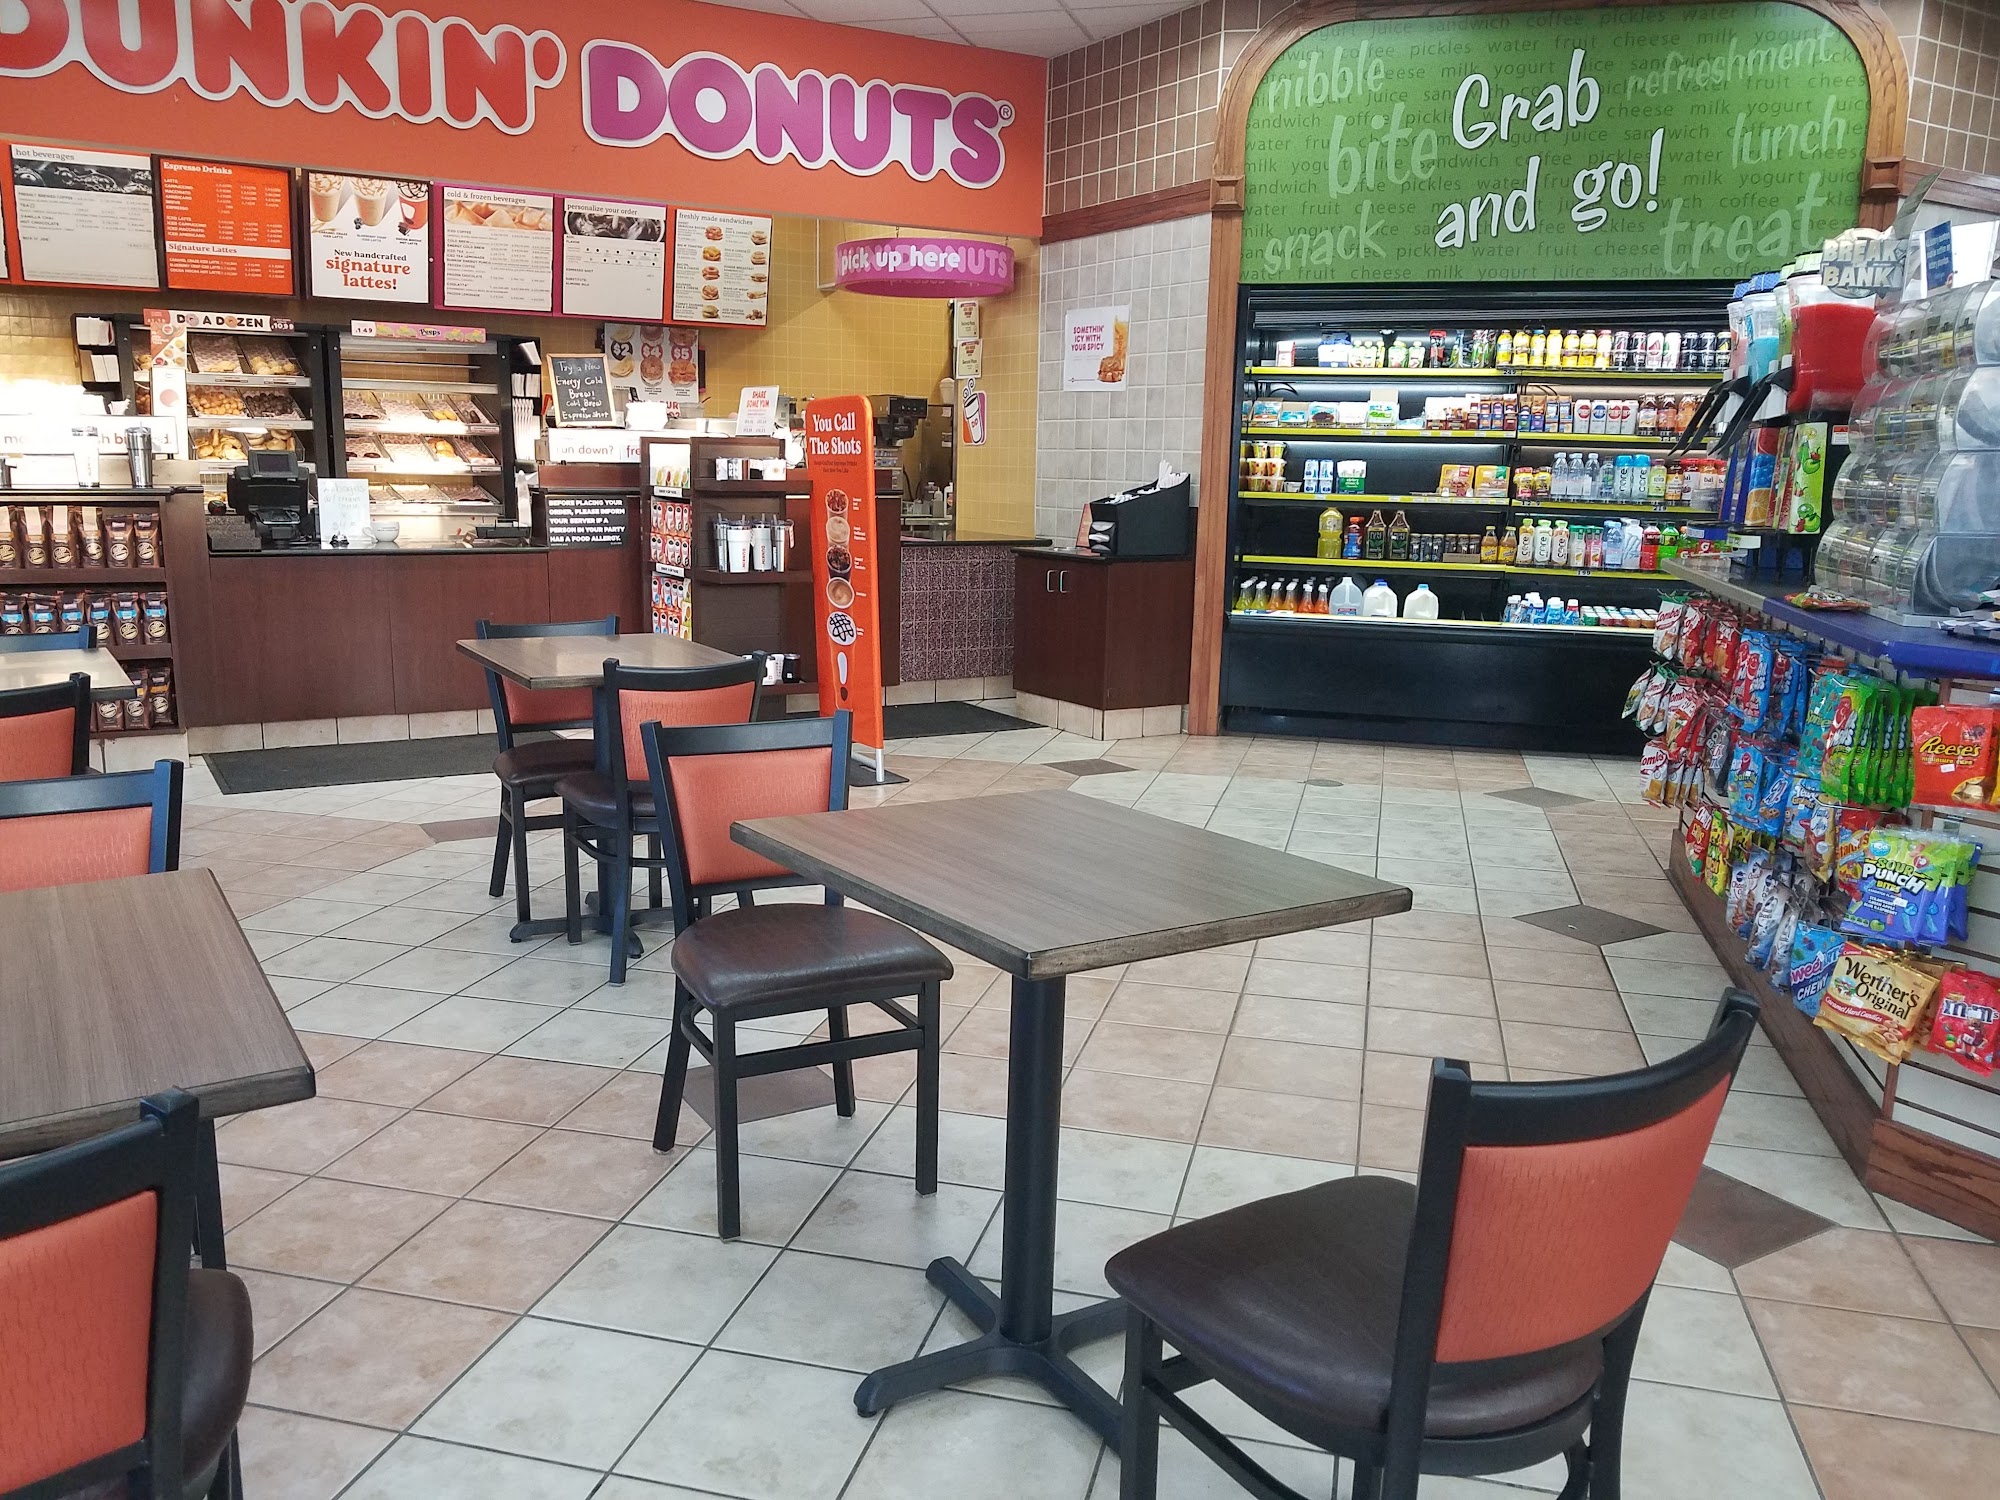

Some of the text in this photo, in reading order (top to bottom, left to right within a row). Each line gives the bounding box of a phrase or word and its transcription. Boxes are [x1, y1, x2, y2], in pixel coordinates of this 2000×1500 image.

[1487, 38, 1540, 53] water
[1555, 34, 1597, 49] fruit
[1613, 31, 1681, 48] cheese
[1493, 60, 1556, 80] yogurt
[1626, 21, 1836, 101] refreshment
[1269, 40, 1386, 113] nibble
[1452, 48, 1600, 149] Grab
[1606, 101, 1674, 119] cheese
[1690, 99, 1731, 116] milk
[1747, 99, 1812, 118] yogurt
[1732, 94, 1847, 170] lunch
[15, 148, 75, 161] hot beverages
[1328, 101, 1438, 199] bite
[163, 161, 233, 175] Espresso Drinks
[1683, 169, 1724, 186] milk
[446, 190, 462, 198] cold
[470, 191, 492, 201] frozen
[493, 194, 527, 205] beverages
[1435, 128, 1665, 249] and go!
[567, 203, 638, 216] personalize your order
[1302, 201, 1341, 216] fruit
[1719, 194, 1780, 209] coffee
[679, 211, 701, 222] freshly
[719, 217, 754, 226] sandwiches
[1658, 172, 1829, 274] treat
[1263, 200, 1387, 275] snack
[168, 242, 238, 254] Signature Lattes
[334, 248, 408, 262] New handcrafted
[1537, 241, 1579, 256] fruit
[1822, 239, 1901, 262] BREAK
[326, 256, 412, 275] signature
[841, 248, 870, 277] pick
[876, 249, 902, 273] up
[909, 244, 961, 269] here
[343, 273, 398, 291] lattes!
[1350, 265, 1412, 280] cheese
[1822, 265, 1896, 287] BANK
[1073, 324, 1105, 335] SOMETHIN'
[1074, 334, 1101, 343] ICY WITH
[613, 342, 631, 357] $2
[642, 342, 662, 357] $4
[673, 345, 690, 358] $5
[1071, 342, 1105, 352] YOUR SPICY
[557, 360, 573, 375] Try
[584, 375, 604, 386] Cold
[592, 410, 610, 419] Shot
[812, 411, 856, 432] You Call
[578, 445, 614, 455] down?
[809, 436, 862, 455] The Shots
[571, 535, 591, 543] FOOD
[1876, 857, 1915, 876] SOUR
[1862, 863, 1927, 895] PUNCH
[1797, 972, 1829, 1001] CHEWY
[1844, 956, 1921, 1009] Werther's
[1825, 995, 1883, 1023] Caramel Hard Candies
[1855, 981, 1912, 1021] Original
